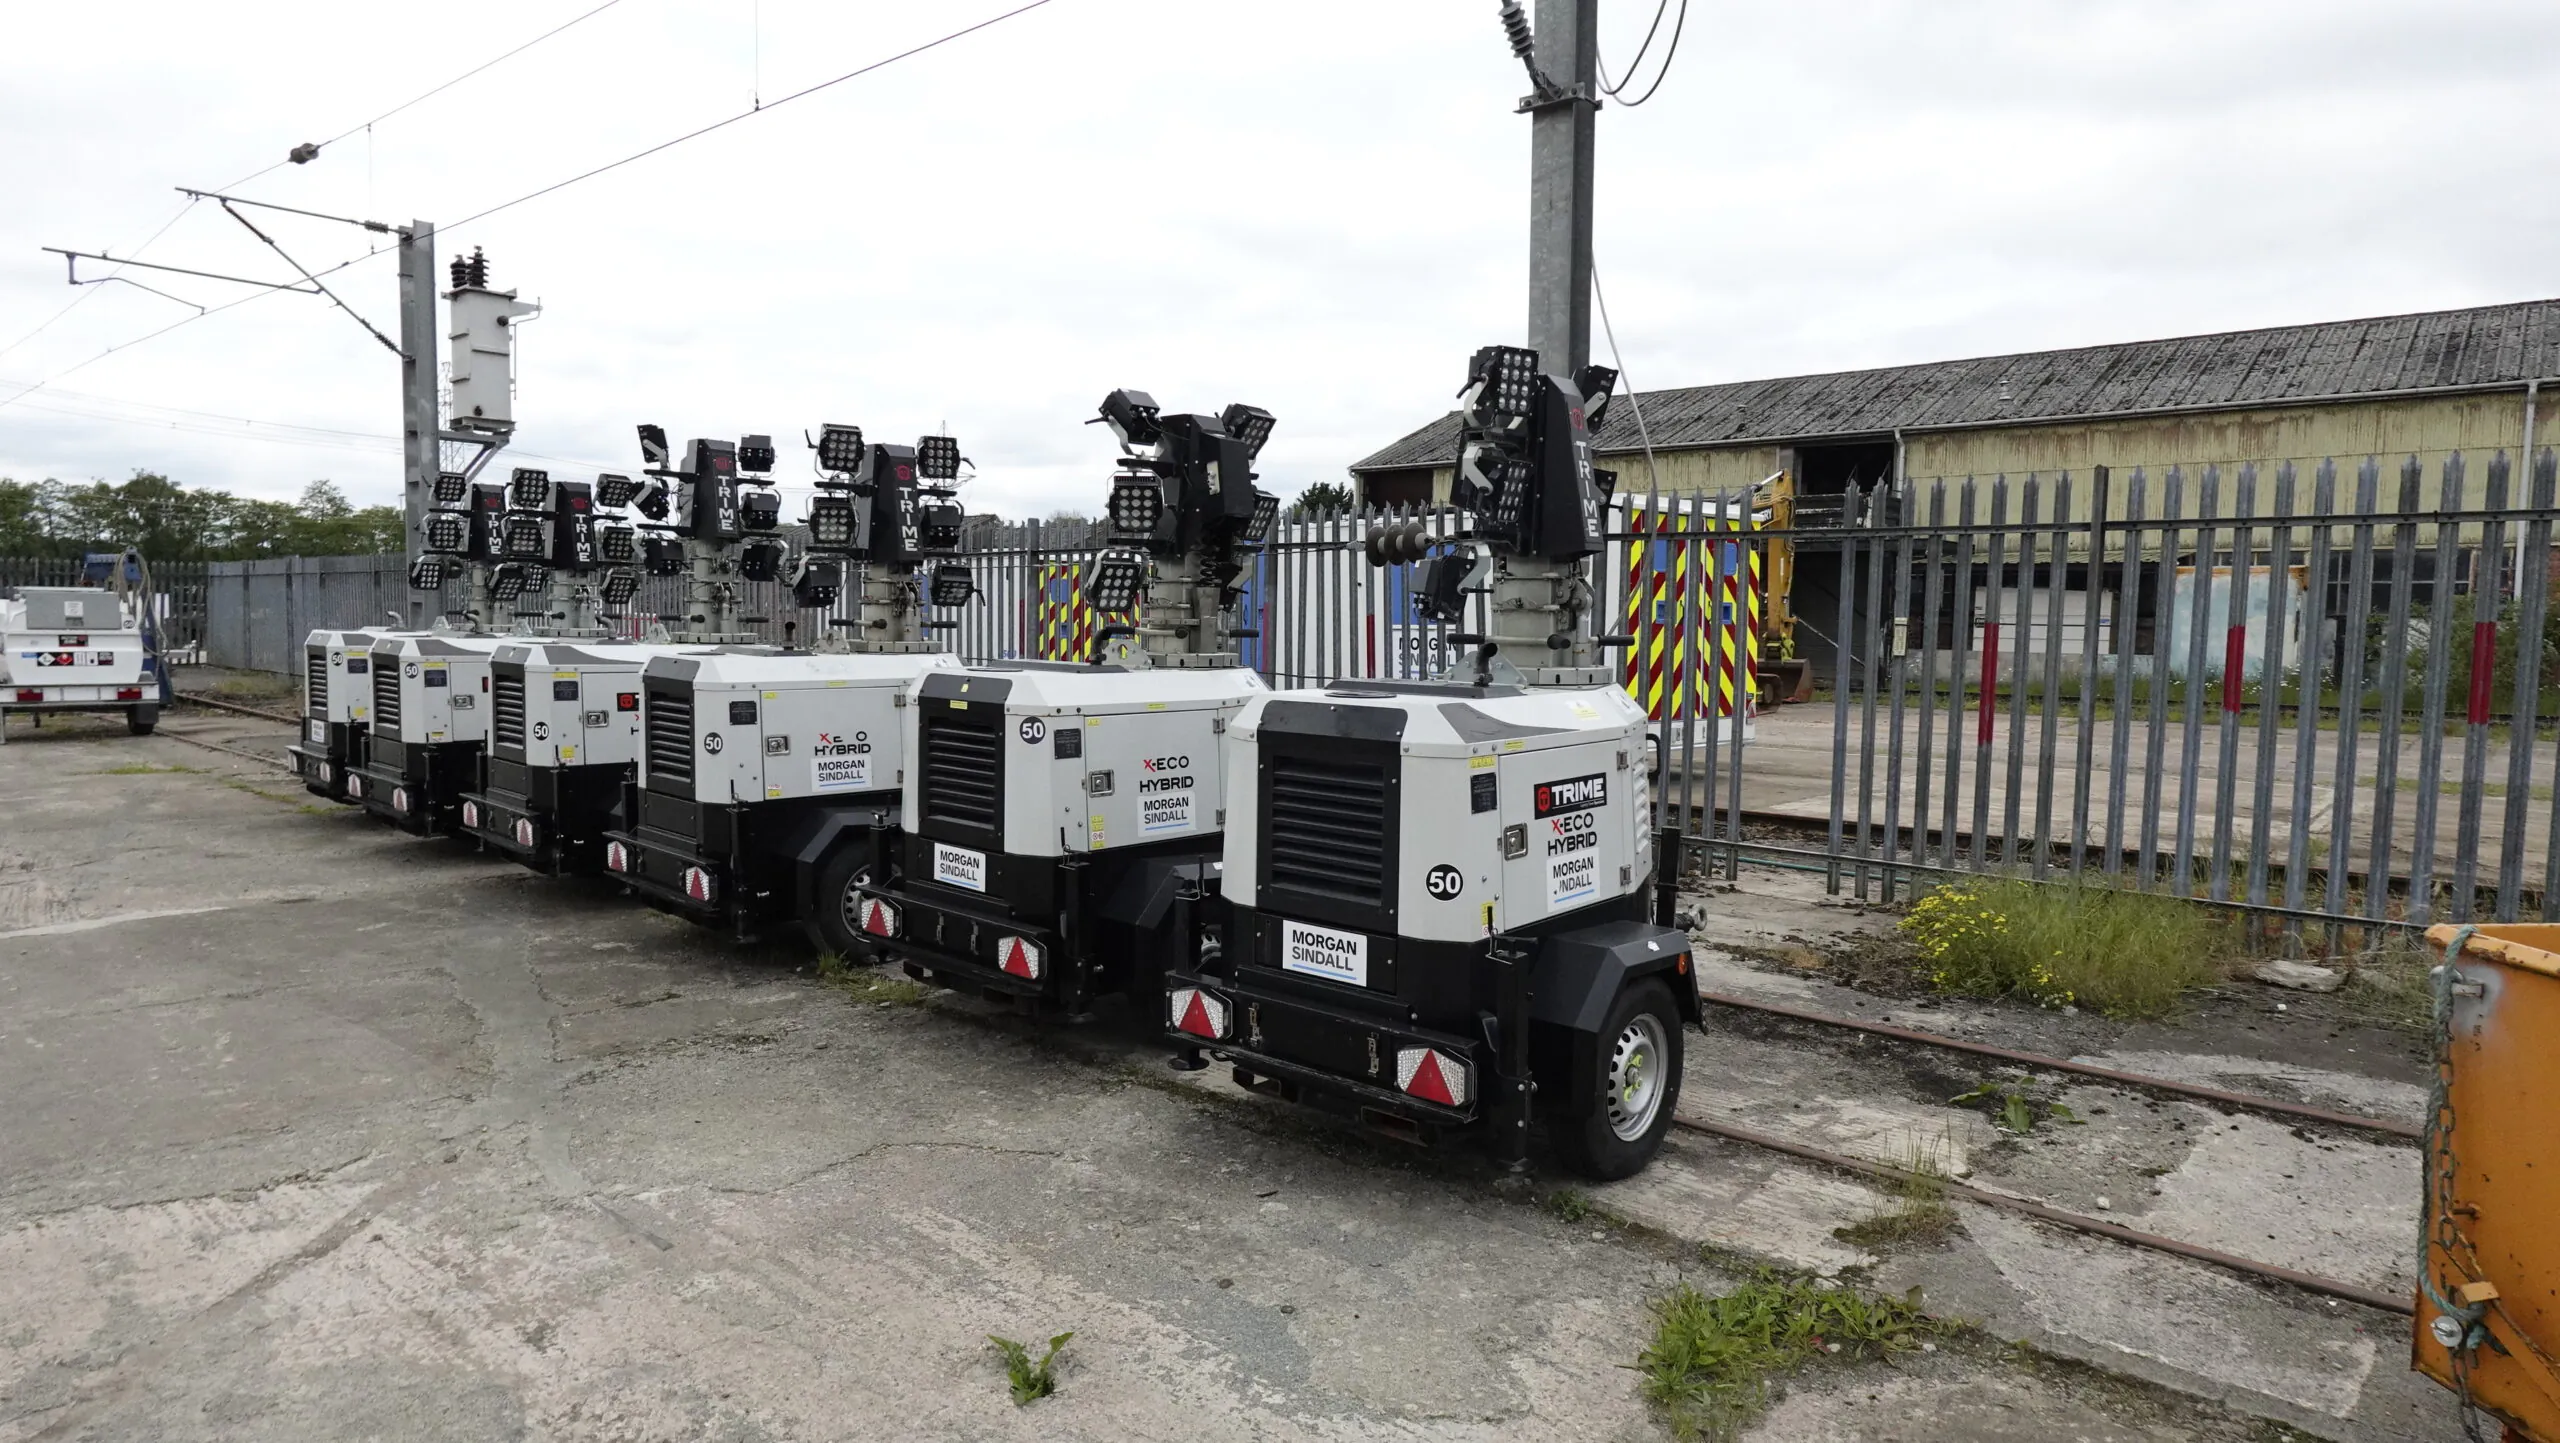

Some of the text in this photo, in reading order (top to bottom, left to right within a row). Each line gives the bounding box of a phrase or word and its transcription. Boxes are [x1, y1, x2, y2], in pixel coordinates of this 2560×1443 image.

[1576, 440, 1599, 537] TRIME
[718, 475, 734, 530] TRIME
[900, 487, 917, 551] TRIME
[575, 514, 591, 562] TRIME
[332, 654, 342, 664] 50
[405, 667, 417, 677] 50
[534, 725, 549, 737] 50
[1022, 722, 1043, 738] 50
[705, 737, 721, 750] 50
[814, 743, 871, 756] HYBRID
[818, 760, 865, 772] MORGAN
[1143, 756, 1189, 772] X-ECO
[818, 770, 863, 782] SINDALL
[1139, 776, 1194, 792] HYBRID
[1551, 777, 1604, 806] TRIME
[1144, 797, 1189, 812] MORGAN
[1144, 810, 1187, 824] SINDALL
[1551, 812, 1594, 835] X-ECO
[1547, 831, 1597, 856] HYBRID
[940, 850, 979, 869] MORGAN
[1553, 856, 1594, 879] MORGAN
[940, 863, 977, 881] SINDALL
[1429, 871, 1460, 894] 50
[1292, 929, 1357, 955] MORGAN
[1292, 946, 1354, 971] SINDALL
